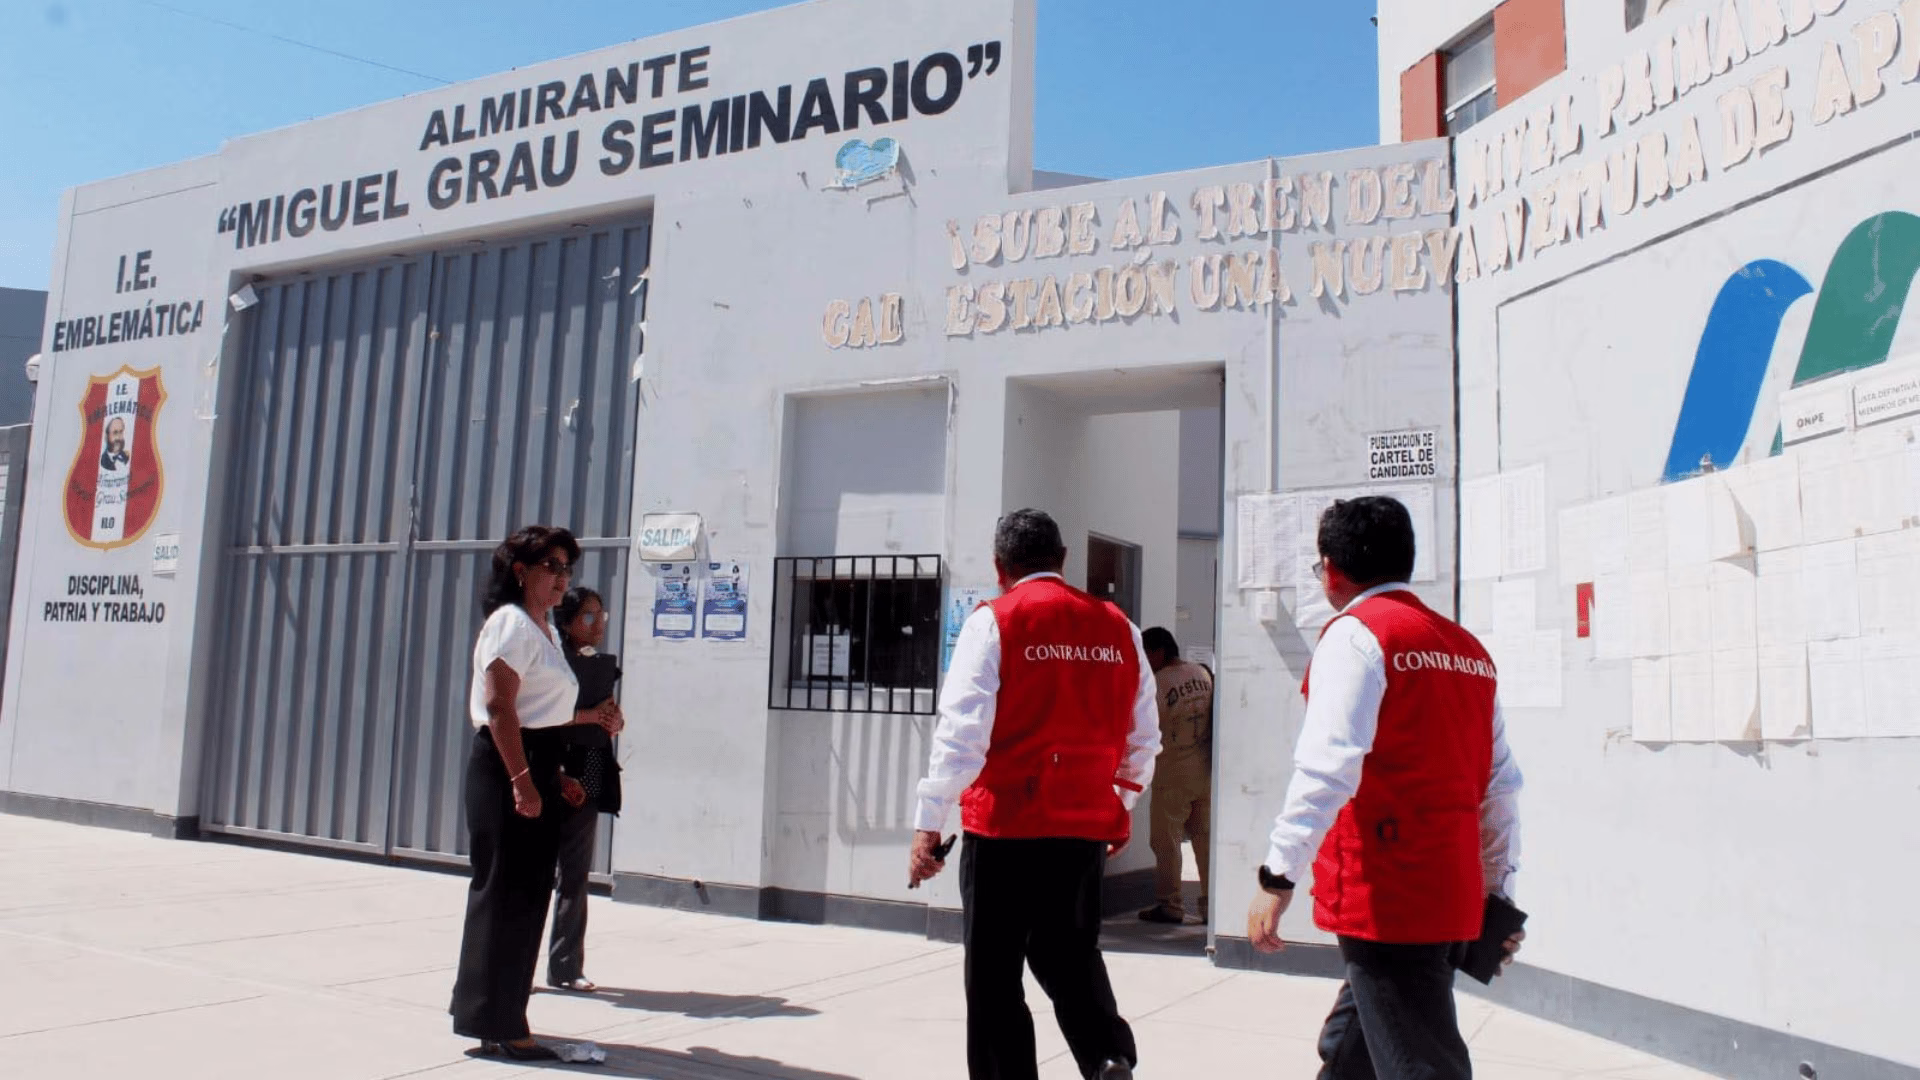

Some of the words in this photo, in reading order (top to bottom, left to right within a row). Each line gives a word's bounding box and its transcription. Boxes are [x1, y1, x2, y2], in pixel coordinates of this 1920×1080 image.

[419, 46, 711, 150] ALMIRANTE
[427, 131, 579, 210] GRAU
[1111, 190, 1178, 249] AL
[1193, 170, 1333, 240] TREN
[1346, 158, 1456, 225] DEL
[1465, 94, 1582, 209] NIVEL
[945, 246, 1178, 335] ESTACIÓN
[1189, 248, 1292, 310] UNA
[1486, 113, 1707, 275] AVENTURA
[1717, 66, 1793, 170] DE
[116, 250, 157, 294] I.E.
[52, 299, 204, 352] EMBLEMÁTICA
[1796, 412, 1825, 429] ONPE
[1423, 433, 1433, 446] DE
[1371, 449, 1414, 465] CARTEL
[1418, 448, 1433, 462] DE
[1370, 463, 1434, 478] CANDIDATOS
[642, 528, 692, 547] SALIDA
[68, 575, 144, 599] DISCIPLINA,
[44, 602, 87, 622] PATRIA
[92, 602, 100, 622] Y
[103, 602, 166, 624] TRABAJO
[1024, 644, 1124, 665] CONTRALORÍA
[1393, 650, 1497, 680] CONTRALORÍA
